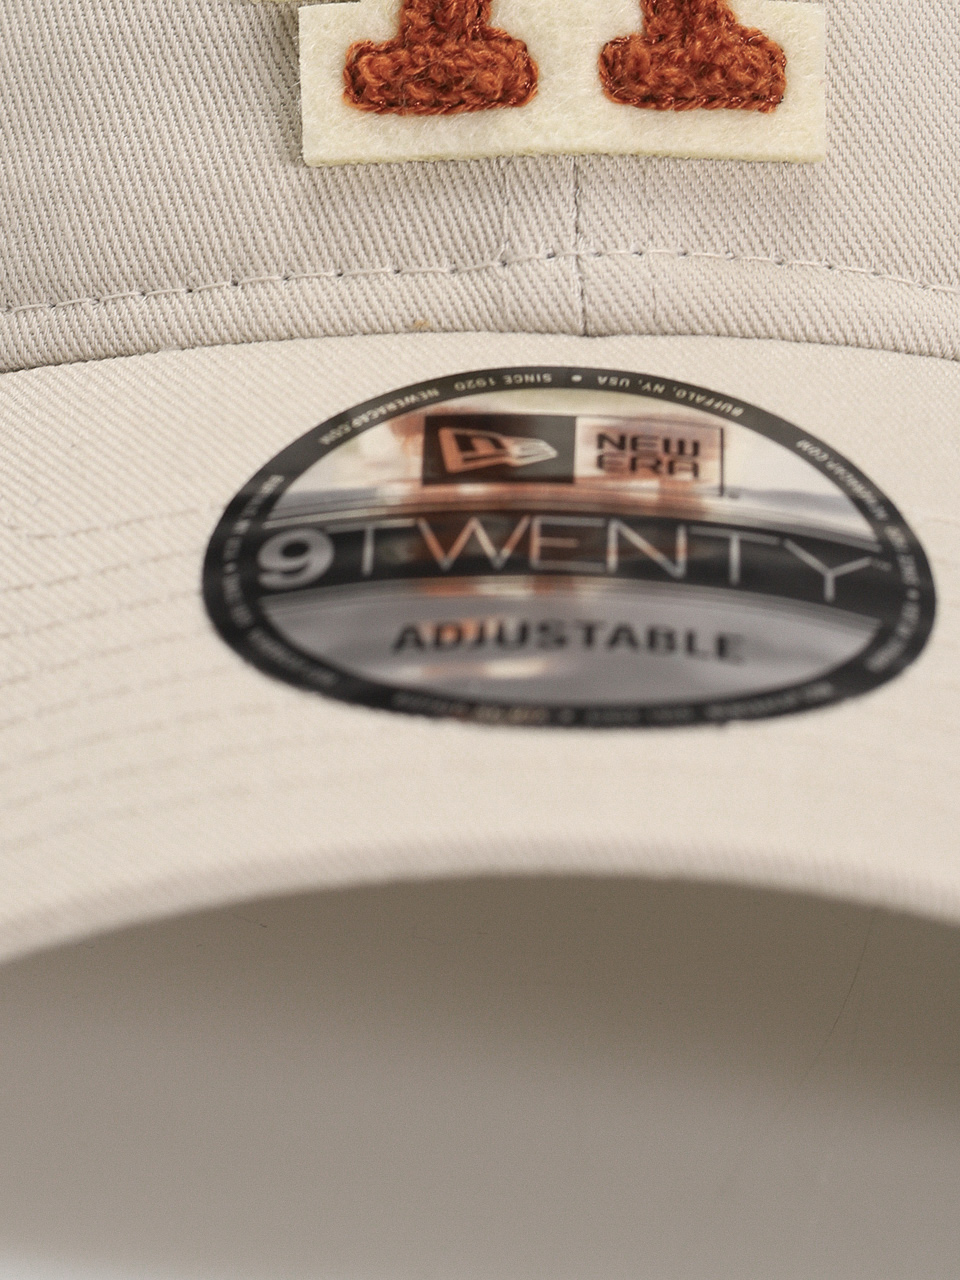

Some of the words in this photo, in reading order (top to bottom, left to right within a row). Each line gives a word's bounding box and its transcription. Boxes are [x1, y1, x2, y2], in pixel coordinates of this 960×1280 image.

[453, 377, 497, 392] 1920
[503, 373, 552, 385] SINCE
[596, 375, 630, 387] USA
[596, 432, 701, 458] NEW
[596, 454, 700, 479] ERA
[392, 618, 746, 668] ADJUSTABLE
